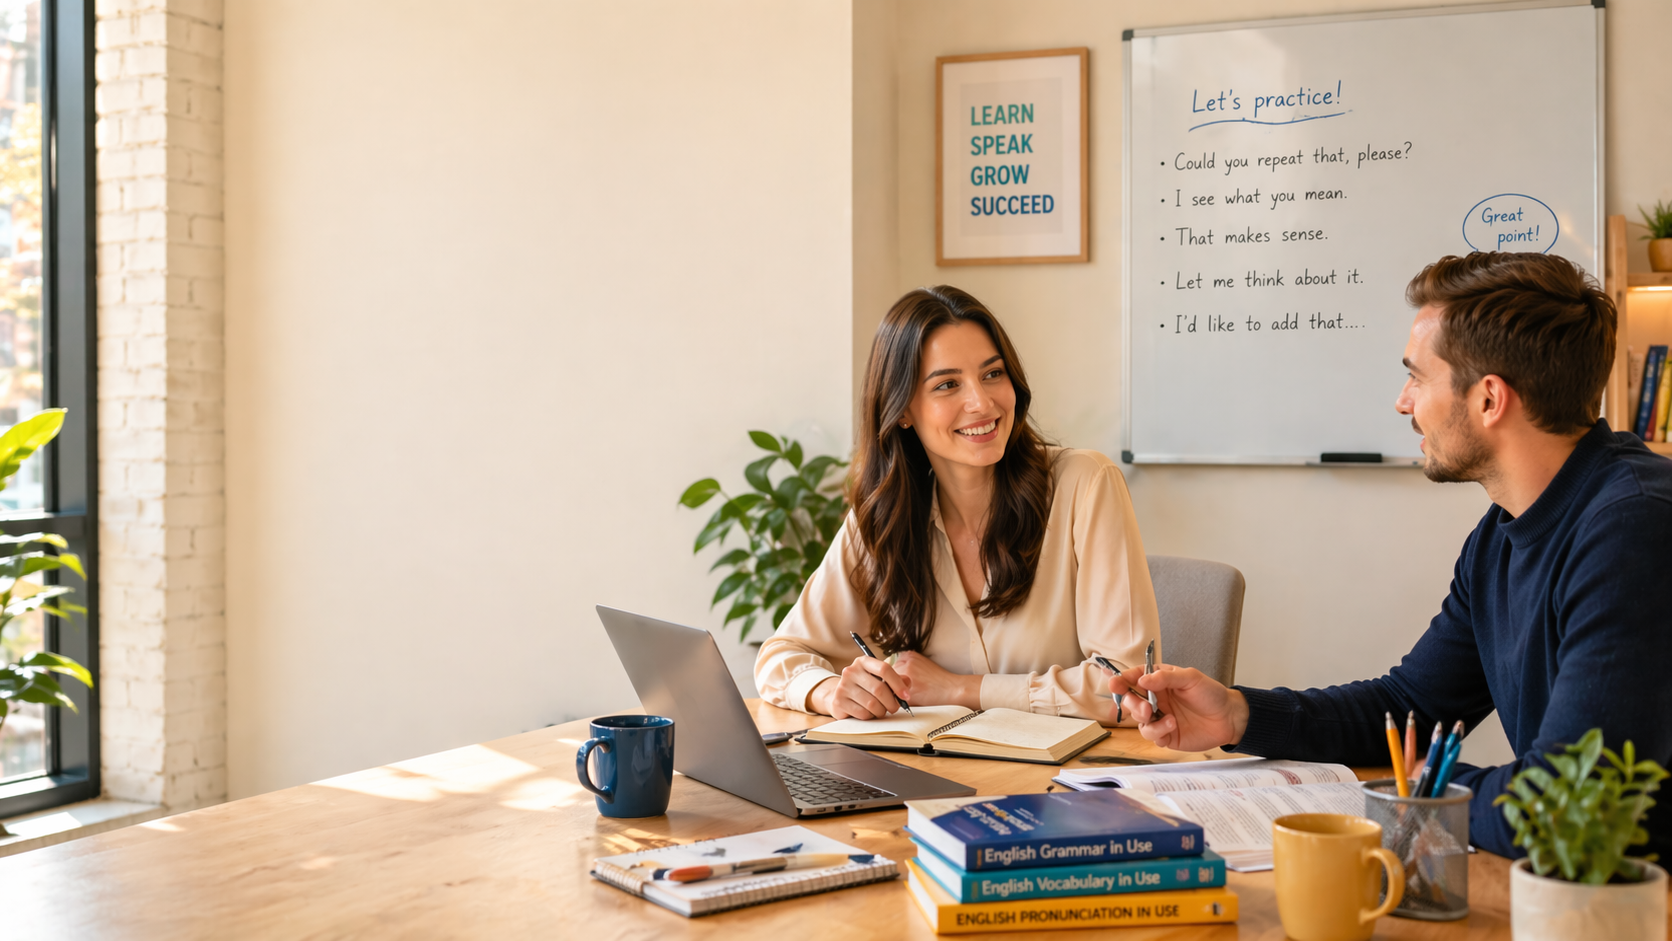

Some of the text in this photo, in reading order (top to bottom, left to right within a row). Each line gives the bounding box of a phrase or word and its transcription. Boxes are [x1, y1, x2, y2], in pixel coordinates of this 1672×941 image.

[1193, 80, 1342, 117] Let's practice!
[971, 103, 1033, 126] LEARN
[971, 134, 1033, 156] SPEAK
[1175, 141, 1413, 176] Could you repeat that, please?
[971, 164, 1029, 186] GROW
[971, 195, 1054, 216] SUCCEED
[1176, 188, 1347, 210] I see what you mean.
[1481, 207, 1524, 227] Great
[1175, 226, 1327, 245] That makes sense.
[1498, 225, 1540, 251] point!
[1176, 268, 1363, 290] Let me think about it.
[1175, 315, 1196, 333] I'd
[1209, 316, 1234, 332] like
[1246, 317, 1261, 331] to
[1272, 313, 1298, 330] add
[985, 839, 1152, 865] English Grammar in Use
[982, 878, 1034, 897] English
[1036, 874, 1115, 891] Vocabulary
[1118, 873, 1132, 886] in
[1135, 871, 1160, 885] Use
[957, 905, 1179, 926] ENGLISH PRONUNCIATION IN USE
